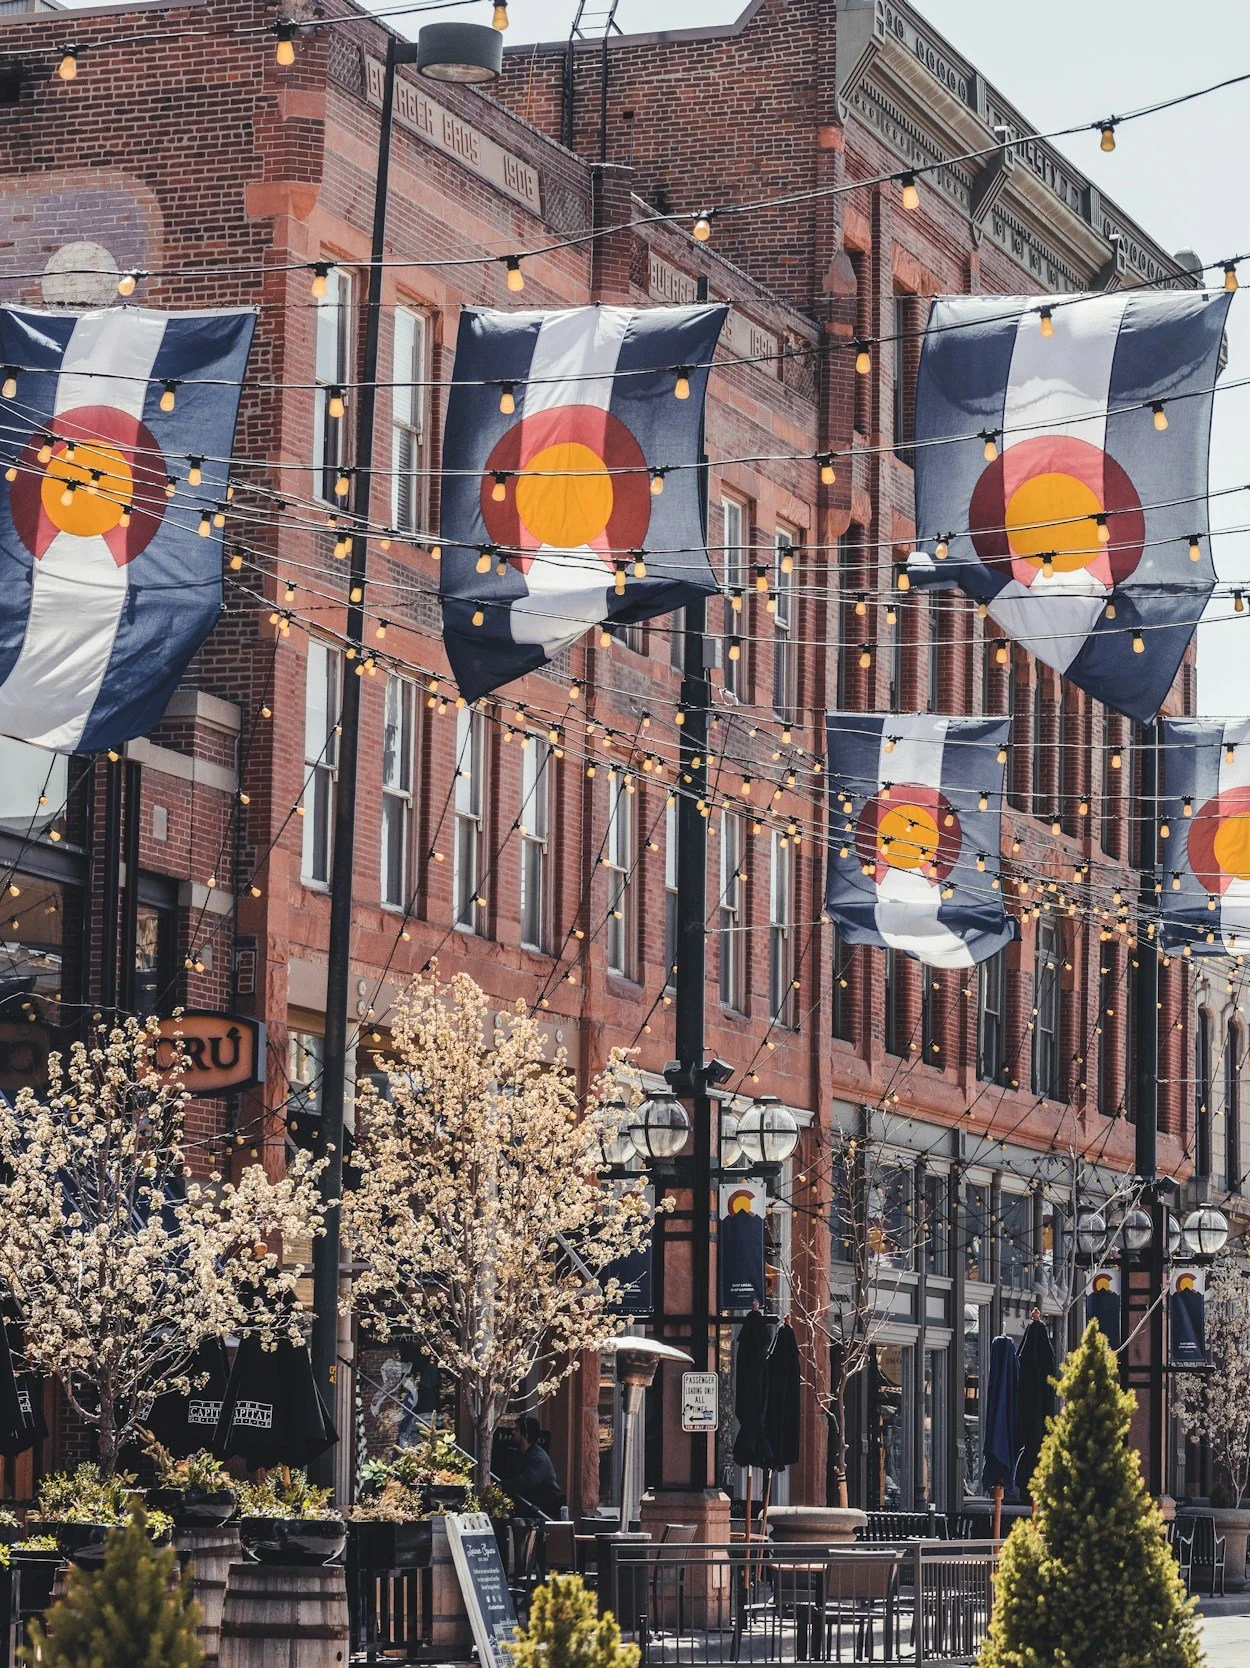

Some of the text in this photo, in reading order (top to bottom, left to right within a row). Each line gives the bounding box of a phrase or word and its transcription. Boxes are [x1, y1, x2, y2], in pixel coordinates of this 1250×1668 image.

[367, 62, 535, 203] BURGER BROS 1908
[685, 1376, 715, 1384] PASSENGER
[685, 1387, 715, 1395] LOADING ONLY
[694, 1396, 705, 1404] ALL
